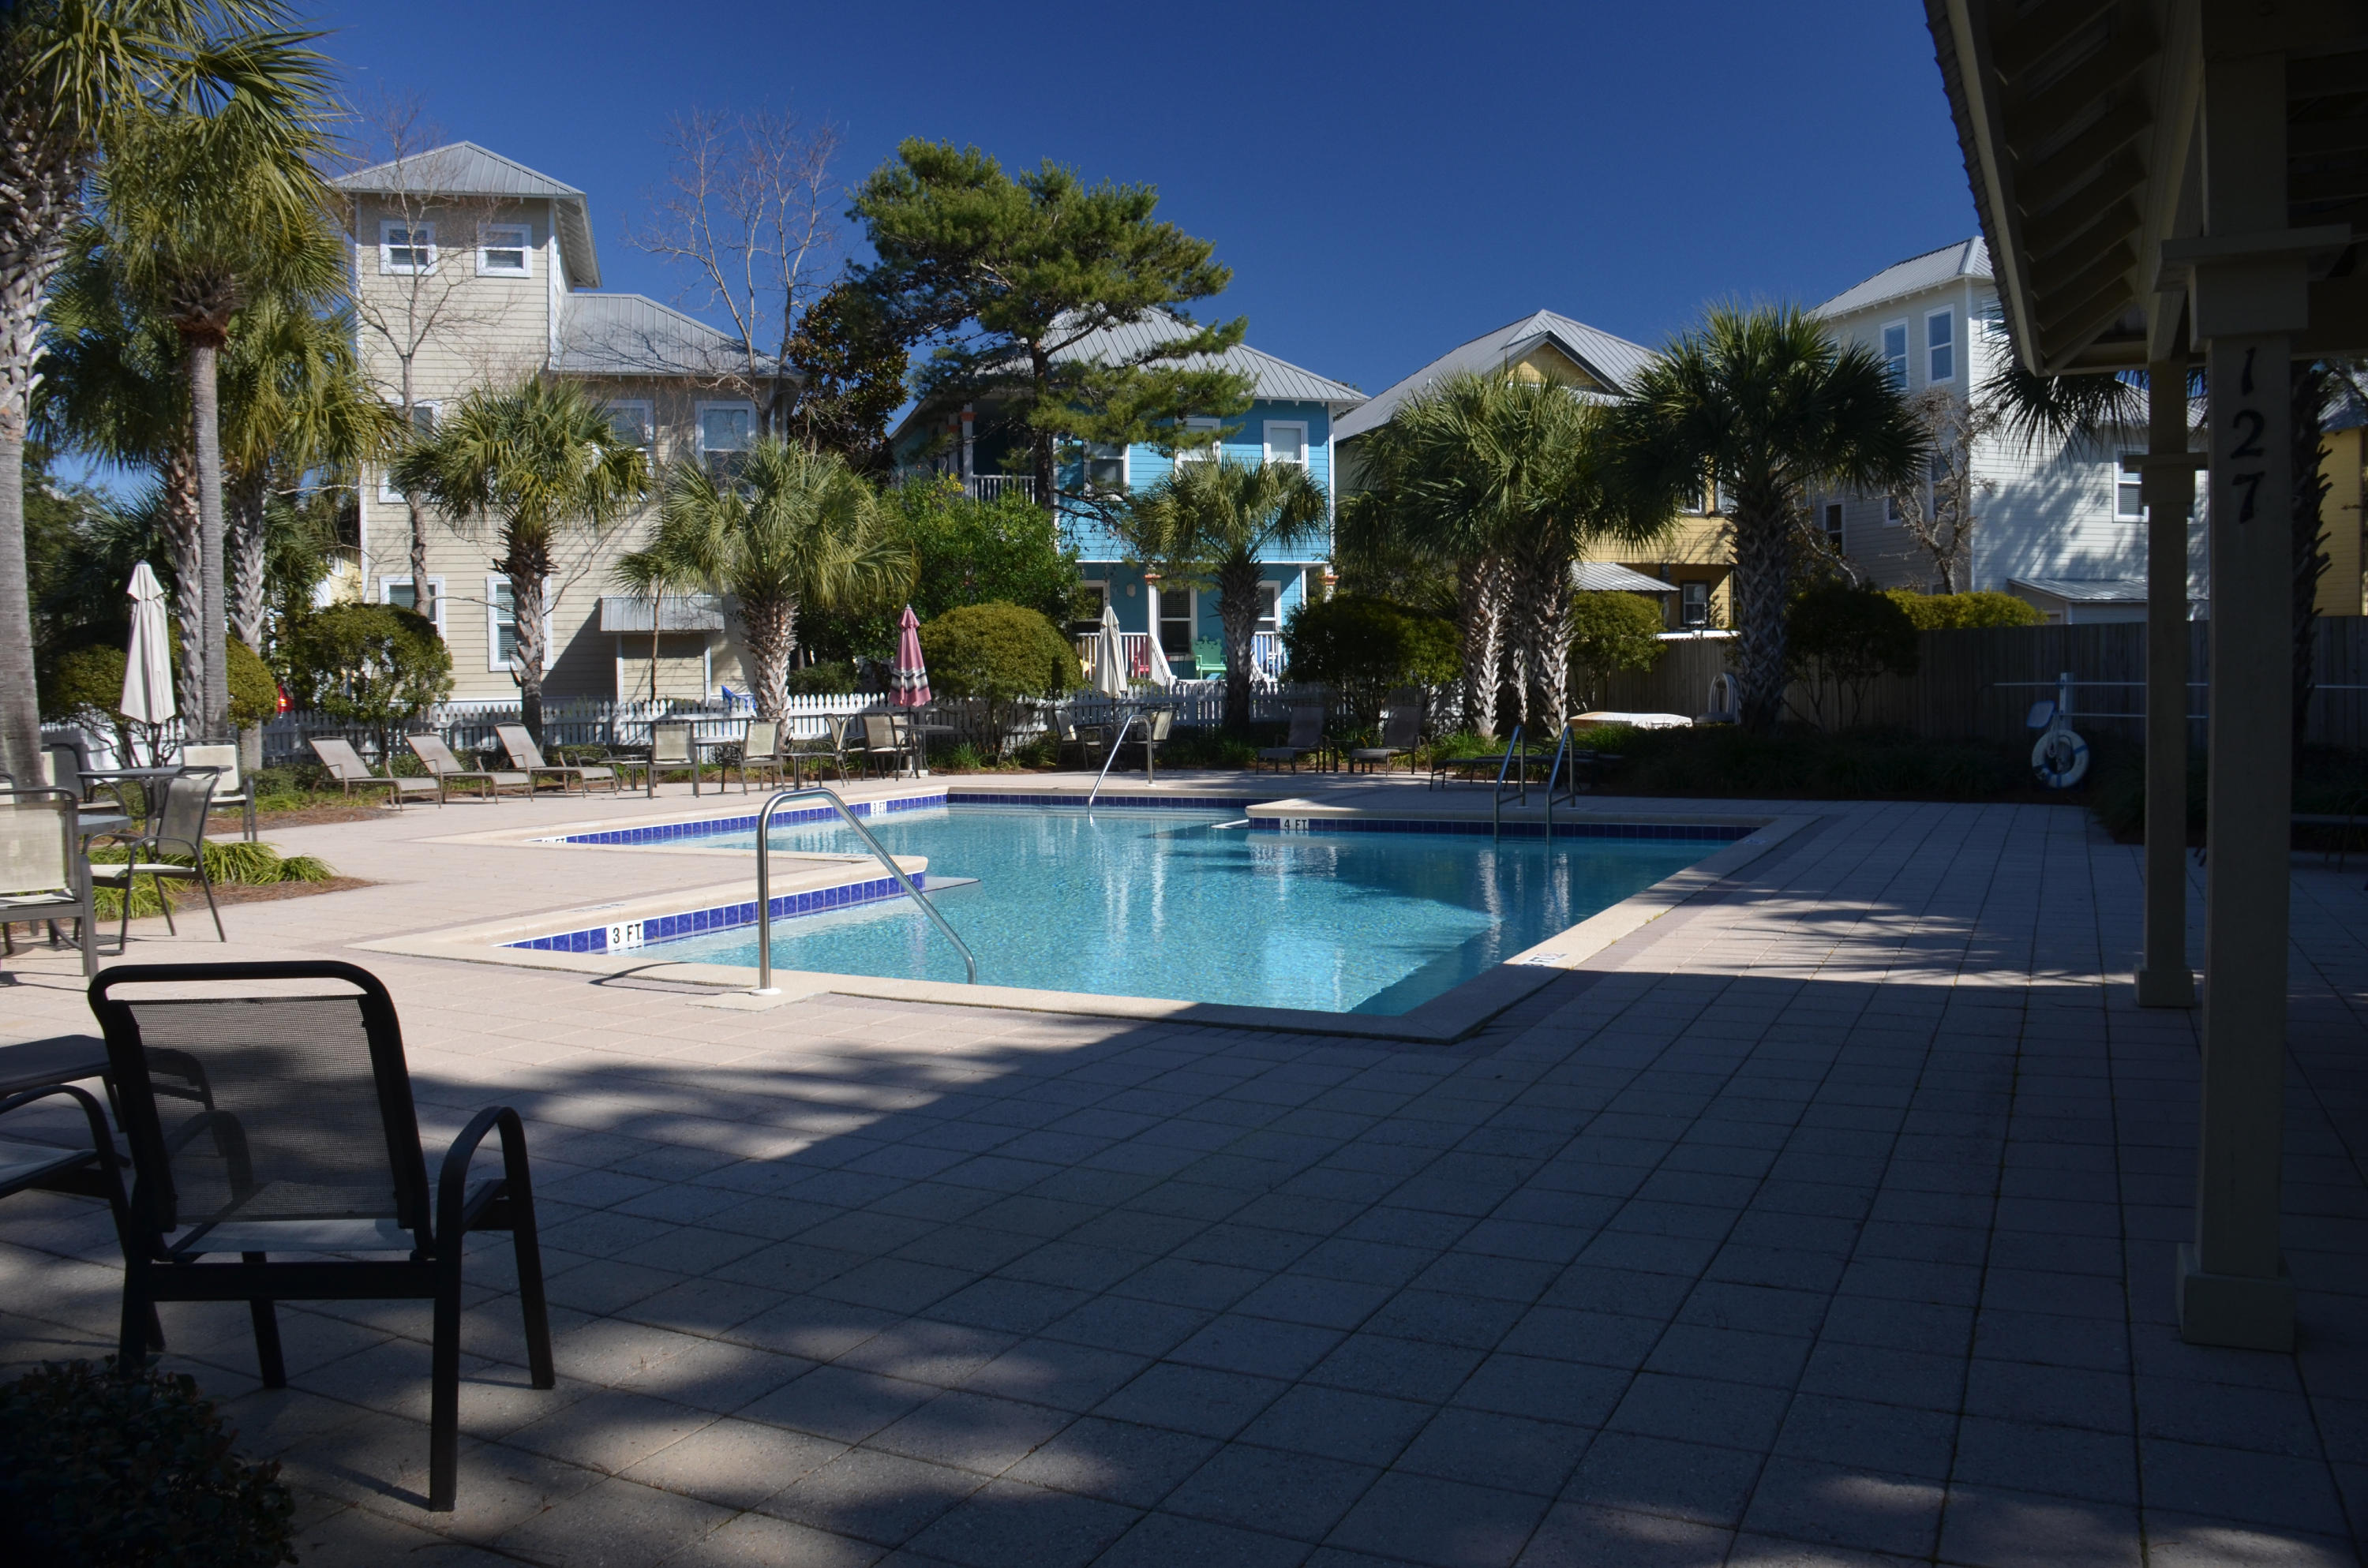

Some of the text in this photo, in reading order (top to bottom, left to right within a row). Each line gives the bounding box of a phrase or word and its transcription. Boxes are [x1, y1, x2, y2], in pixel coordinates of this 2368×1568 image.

[2230, 346, 2265, 525] 127
[1284, 818, 1291, 830] 4
[613, 927, 620, 944] 3
